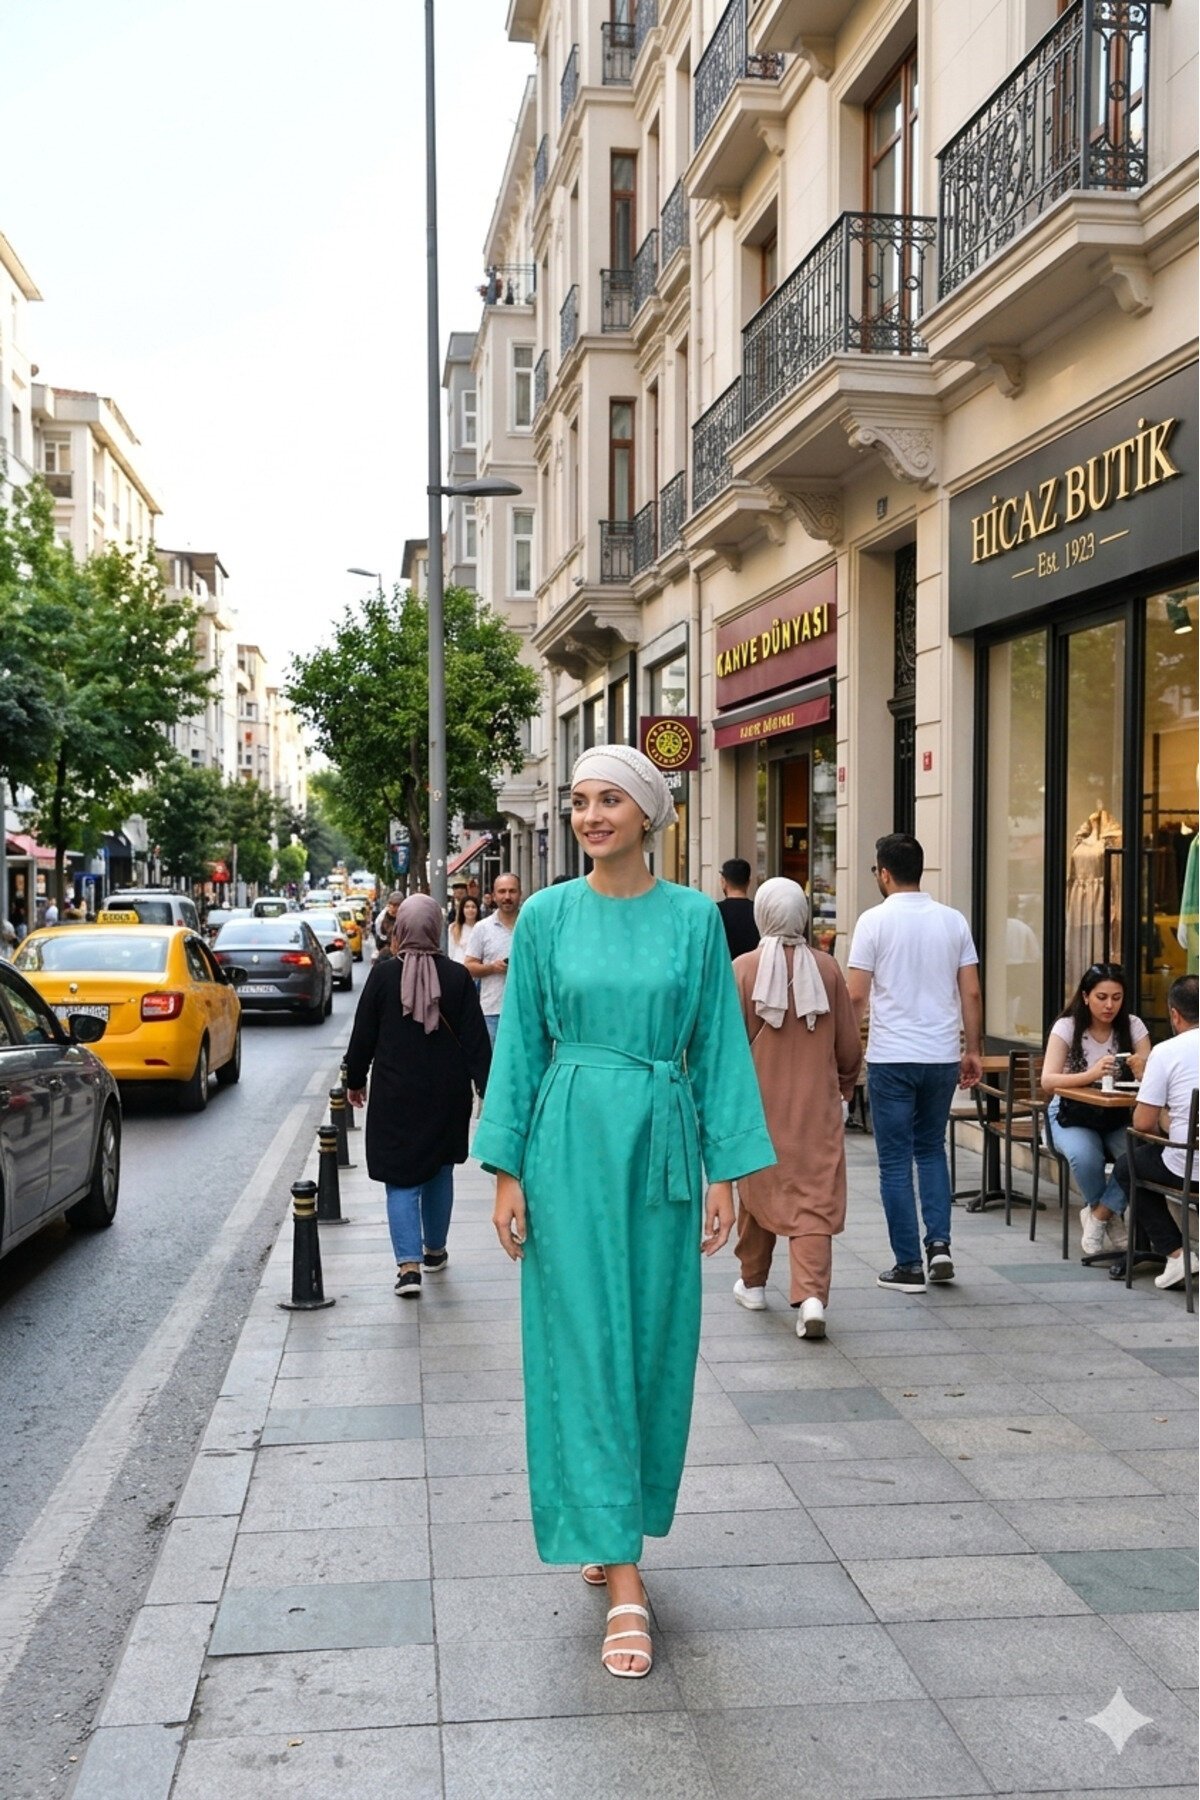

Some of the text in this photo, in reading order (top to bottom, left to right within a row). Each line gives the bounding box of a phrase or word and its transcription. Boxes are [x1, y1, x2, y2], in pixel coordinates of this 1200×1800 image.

[971, 417, 1180, 564] HİCAZ BUTİK
[1065, 532, 1095, 569] 1923
[761, 603, 828, 659] DÜNYASI
